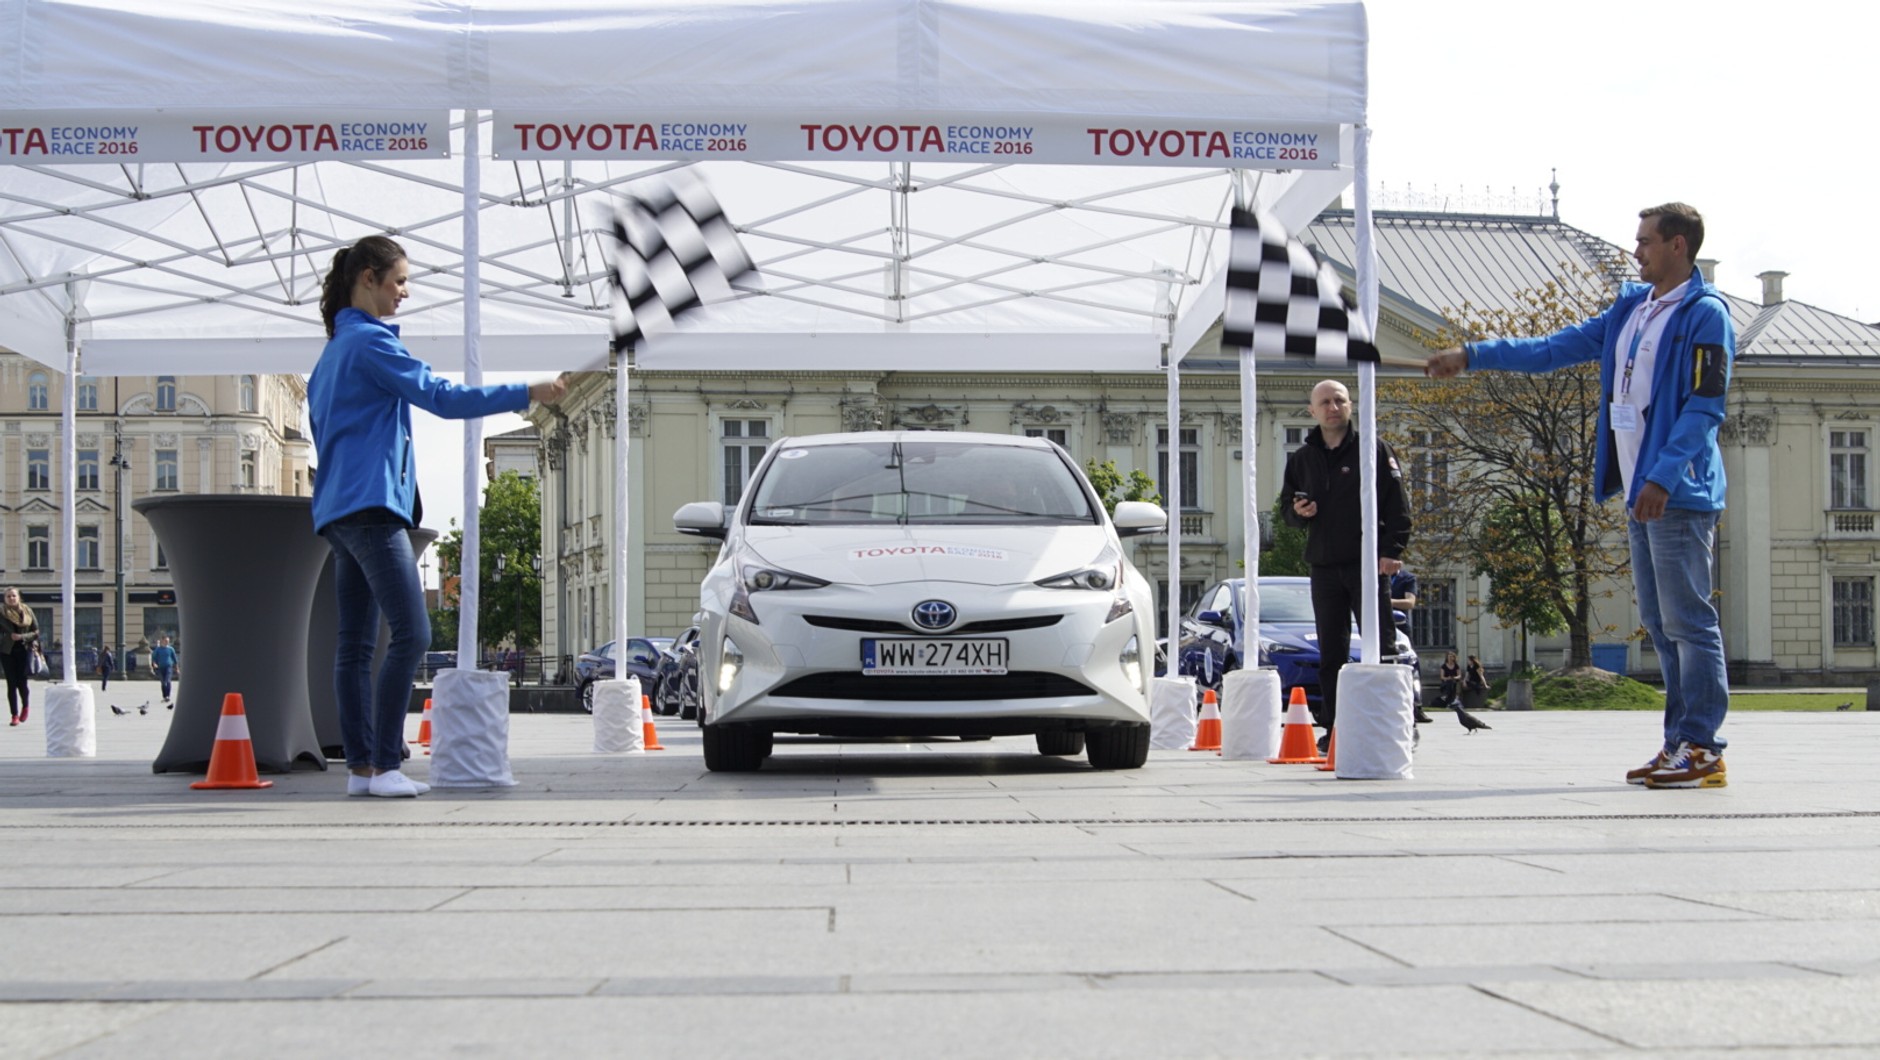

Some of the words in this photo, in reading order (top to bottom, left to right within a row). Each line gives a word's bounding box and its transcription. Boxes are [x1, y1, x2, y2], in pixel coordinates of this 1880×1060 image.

[51, 127, 138, 140] ECONOMY
[340, 123, 428, 137] ECONOMY
[512, 123, 658, 152] TOYOTA
[661, 124, 747, 137] ECONOMY
[947, 126, 1033, 140] ECONOMY
[0, 127, 49, 155] TA
[192, 123, 339, 153] TOYOTA
[341, 138, 384, 152] RACE
[388, 137, 428, 151] 2016
[661, 138, 704, 152] RACE
[707, 138, 747, 152] 2016
[800, 123, 945, 153] TOYOTA
[1087, 128, 1231, 159] TOYOTA
[1232, 131, 1318, 147] ECONOMY
[51, 141, 95, 155] RACE
[98, 141, 138, 155] 2016
[947, 140, 990, 154] RACE
[993, 141, 1033, 155] 2016
[1232, 144, 1276, 160] RACE
[1279, 147, 1318, 161] 2016
[854, 546, 945, 558] TOYOTA
[880, 643, 915, 666] WW
[925, 643, 1002, 666] 274XH
